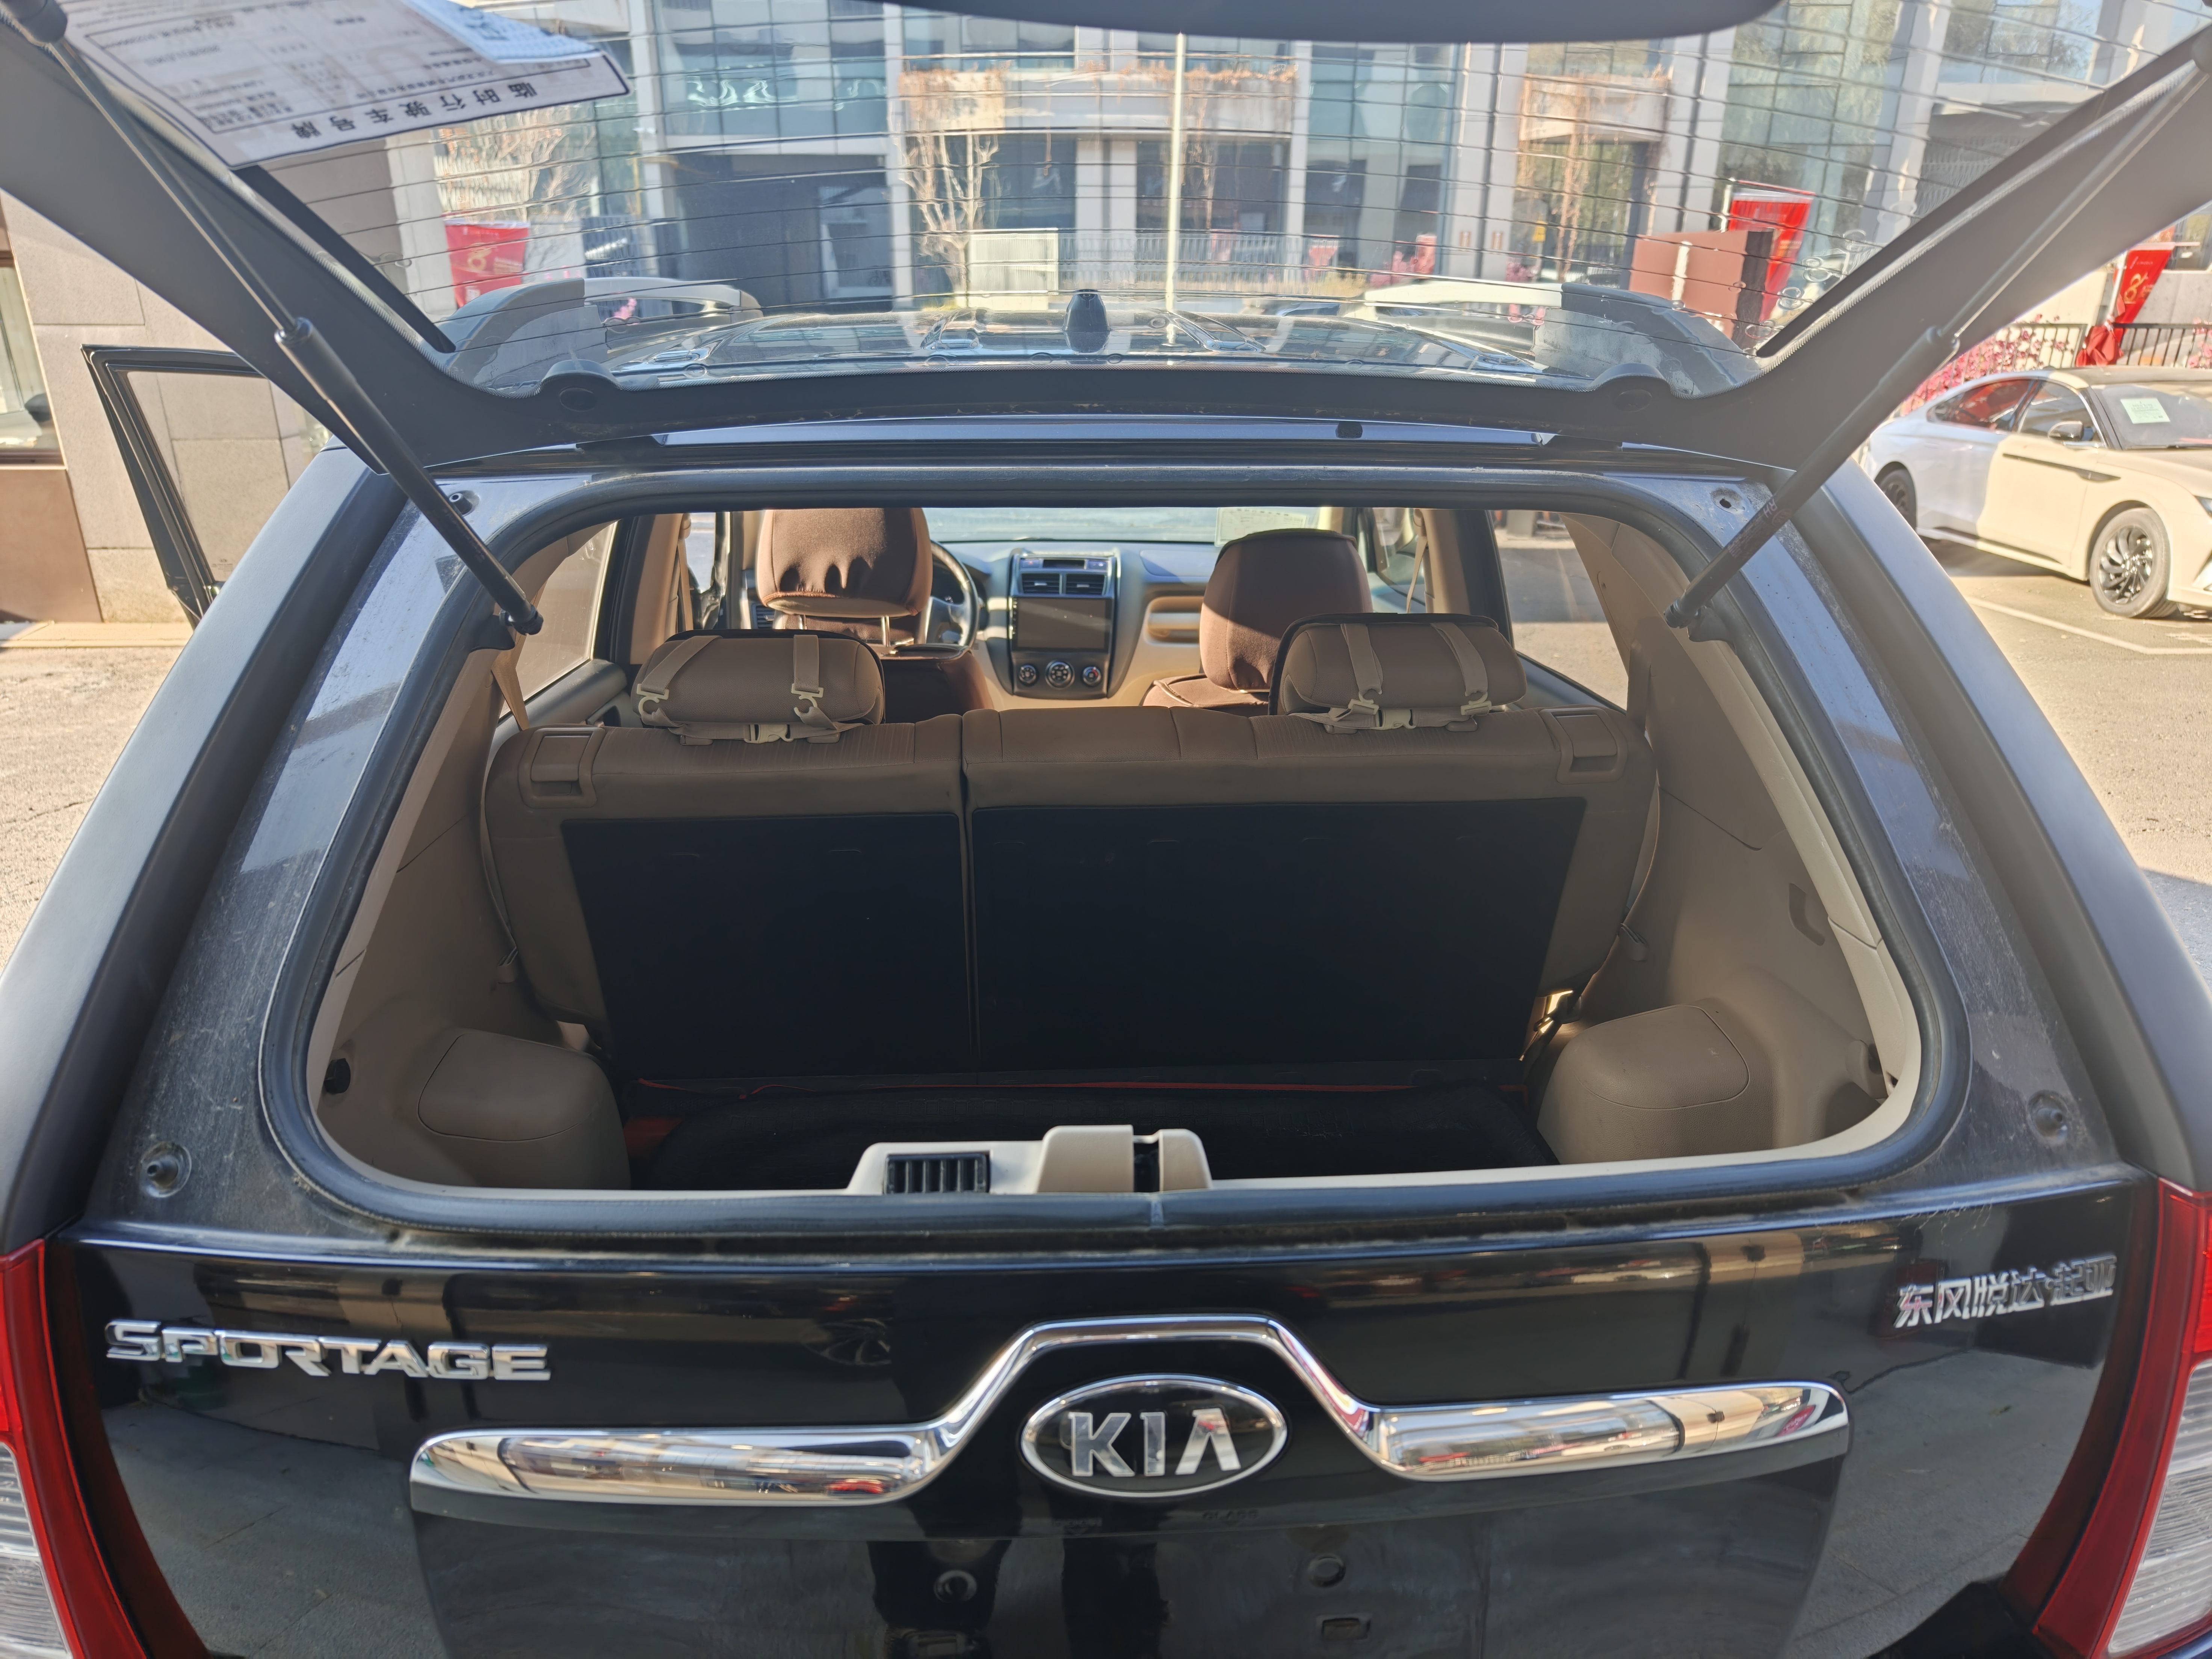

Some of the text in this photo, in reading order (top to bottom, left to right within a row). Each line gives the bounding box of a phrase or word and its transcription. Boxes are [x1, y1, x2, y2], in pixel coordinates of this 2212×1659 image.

[291, 82, 538, 139] 临时行驶车号牌
[106, 1319, 551, 1381] SPORTAGE
[1068, 1408, 1242, 1477] KIA
